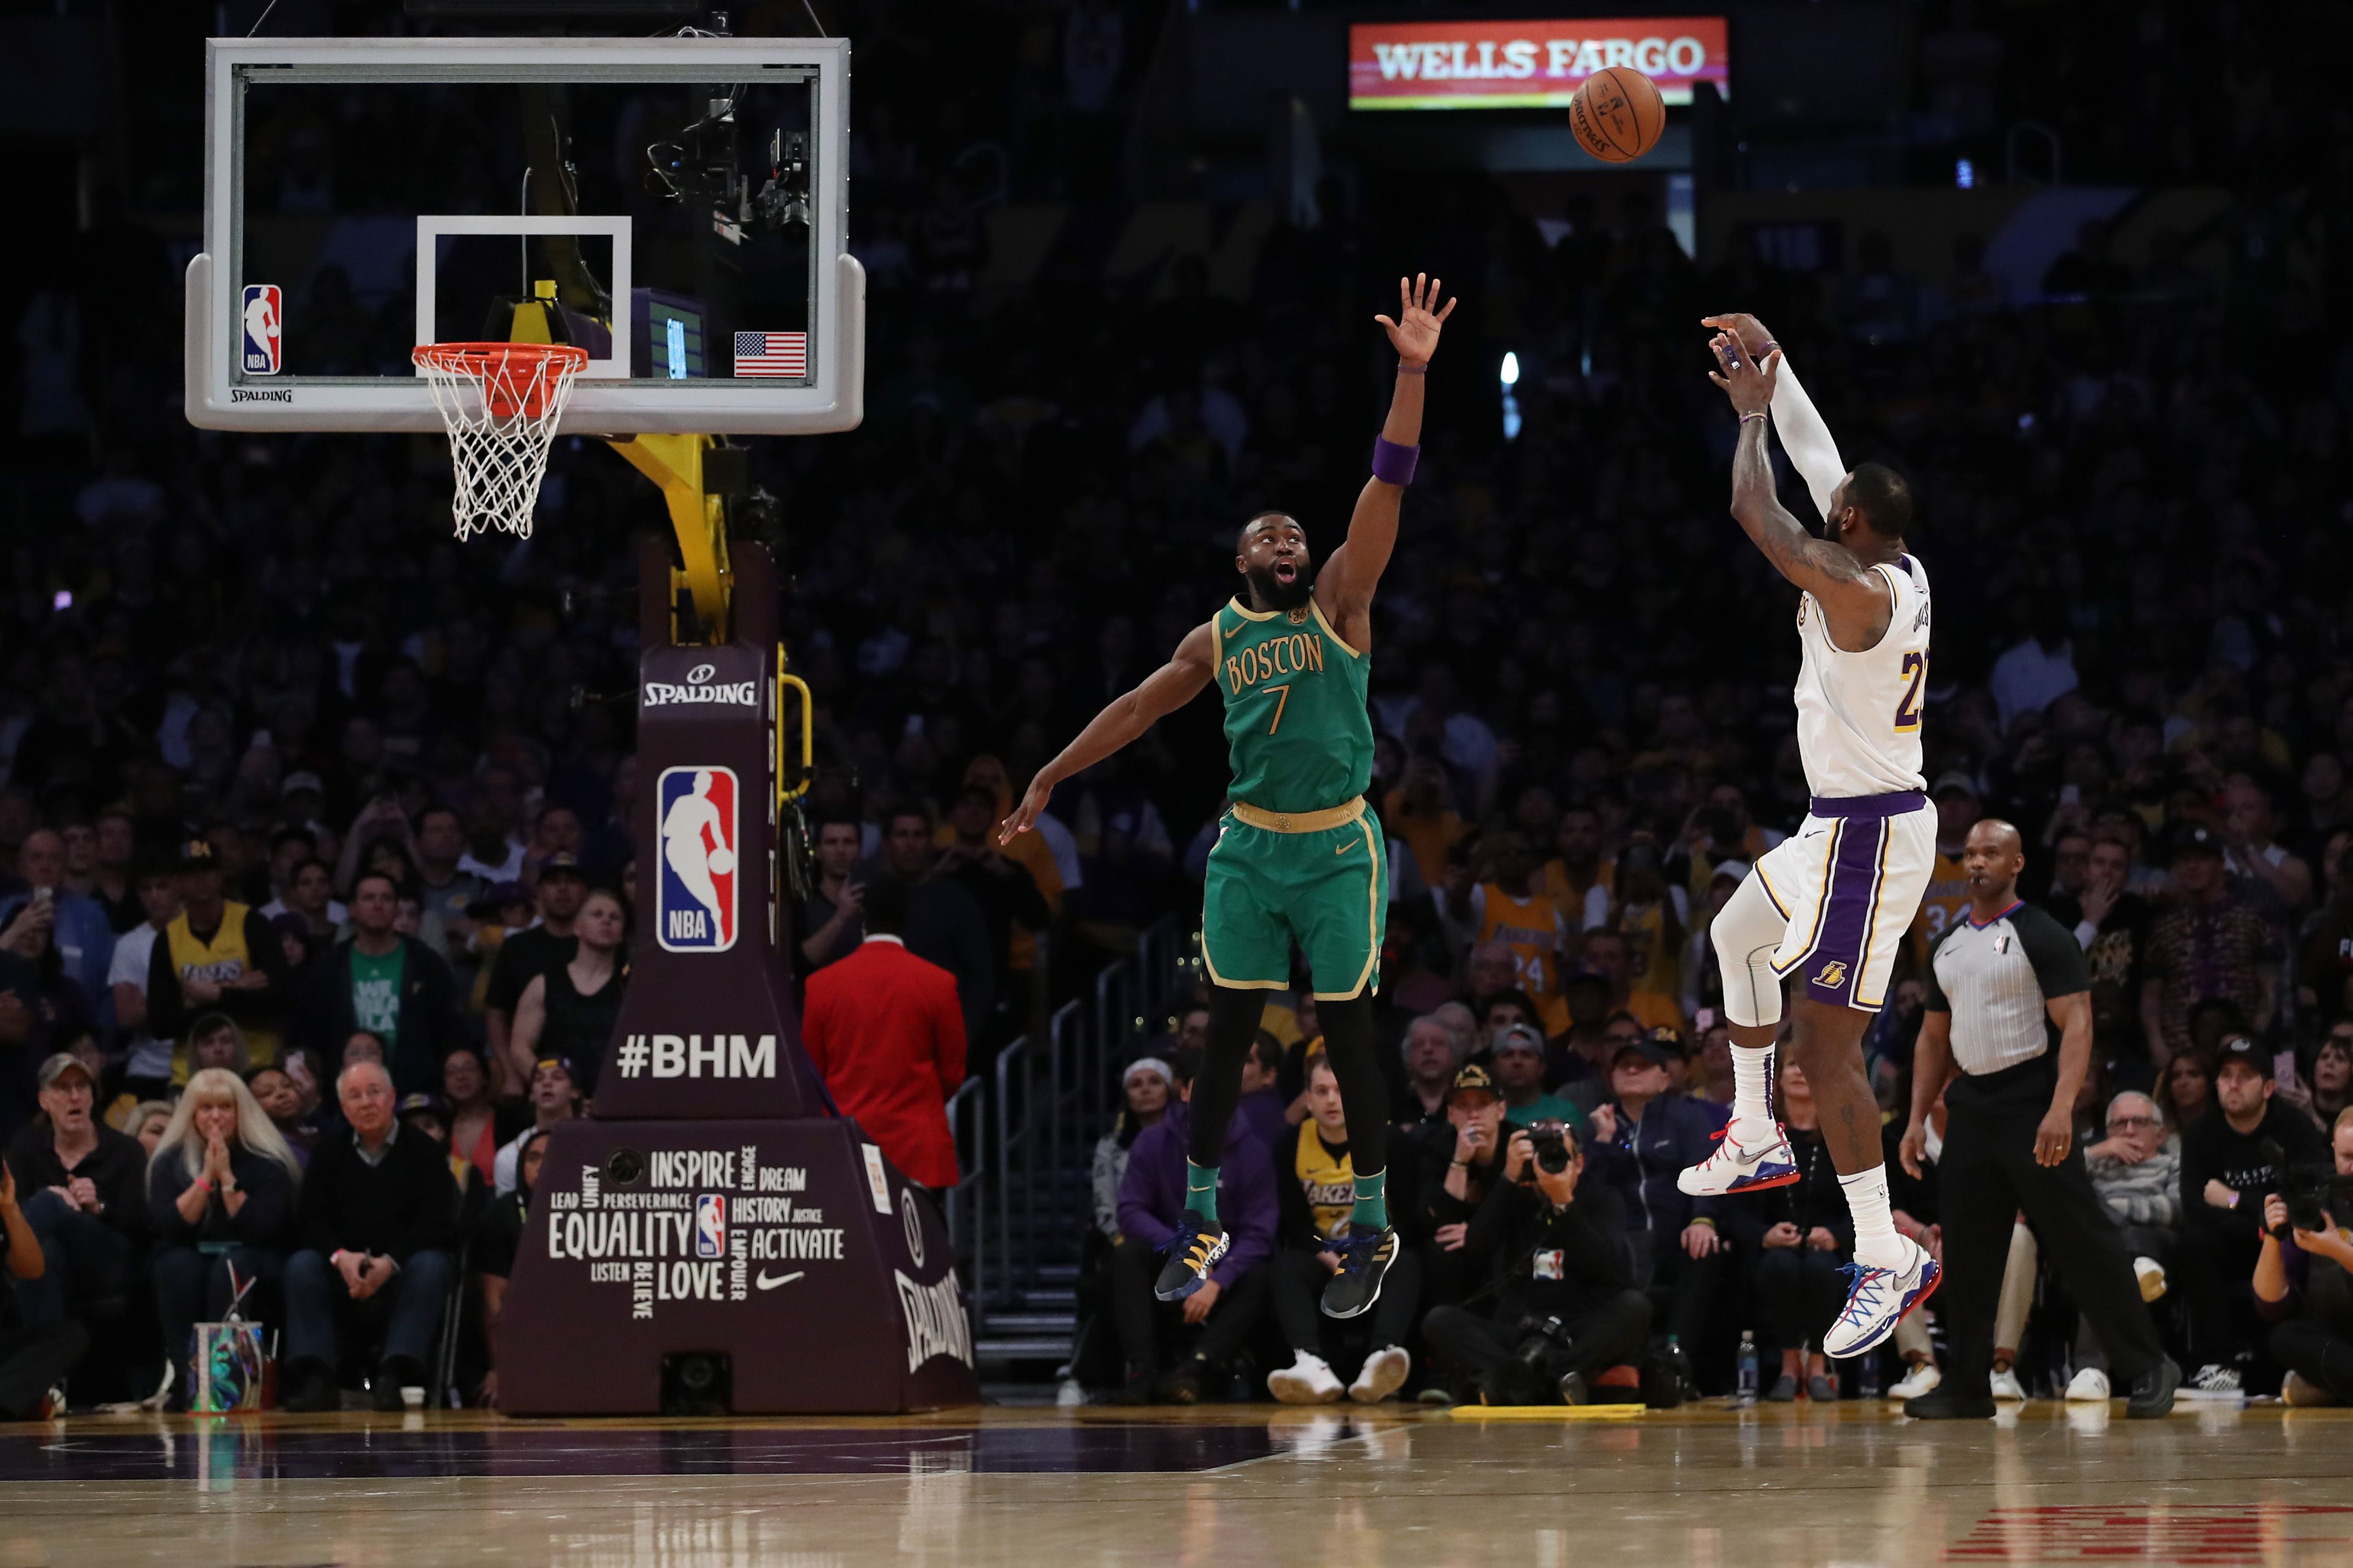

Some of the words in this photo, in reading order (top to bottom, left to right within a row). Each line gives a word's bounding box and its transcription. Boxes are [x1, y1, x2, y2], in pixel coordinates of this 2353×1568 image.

[1373, 40, 1539, 81] WELLS
[1546, 36, 1705, 77] FARGO
[248, 354, 266, 369] NBA
[231, 389, 292, 403] SPALDING
[1226, 632, 1324, 696] BOSTON
[644, 681, 758, 707] SPALDING
[1261, 684, 1290, 736] 7
[669, 910, 707, 939] NBA
[617, 1034, 776, 1078] #BHM
[651, 1150, 737, 1188] INSPIRE
[741, 1145, 757, 1191] ENGAGE
[759, 1167, 807, 1192] DREAM
[551, 1192, 580, 1209] LEAD
[582, 1164, 600, 1208] UNIFY
[603, 1192, 692, 1209] PERSEVERANCE
[731, 1196, 792, 1224] HISTORY
[791, 1208, 823, 1224] JUSTICE
[549, 1211, 693, 1261] EQUALITY
[751, 1228, 844, 1260] ACTIVATE
[591, 1262, 630, 1282] LISTEN
[657, 1260, 725, 1301] LOVE
[730, 1229, 748, 1301] EMPOWER
[633, 1262, 654, 1319] BELIEVE
